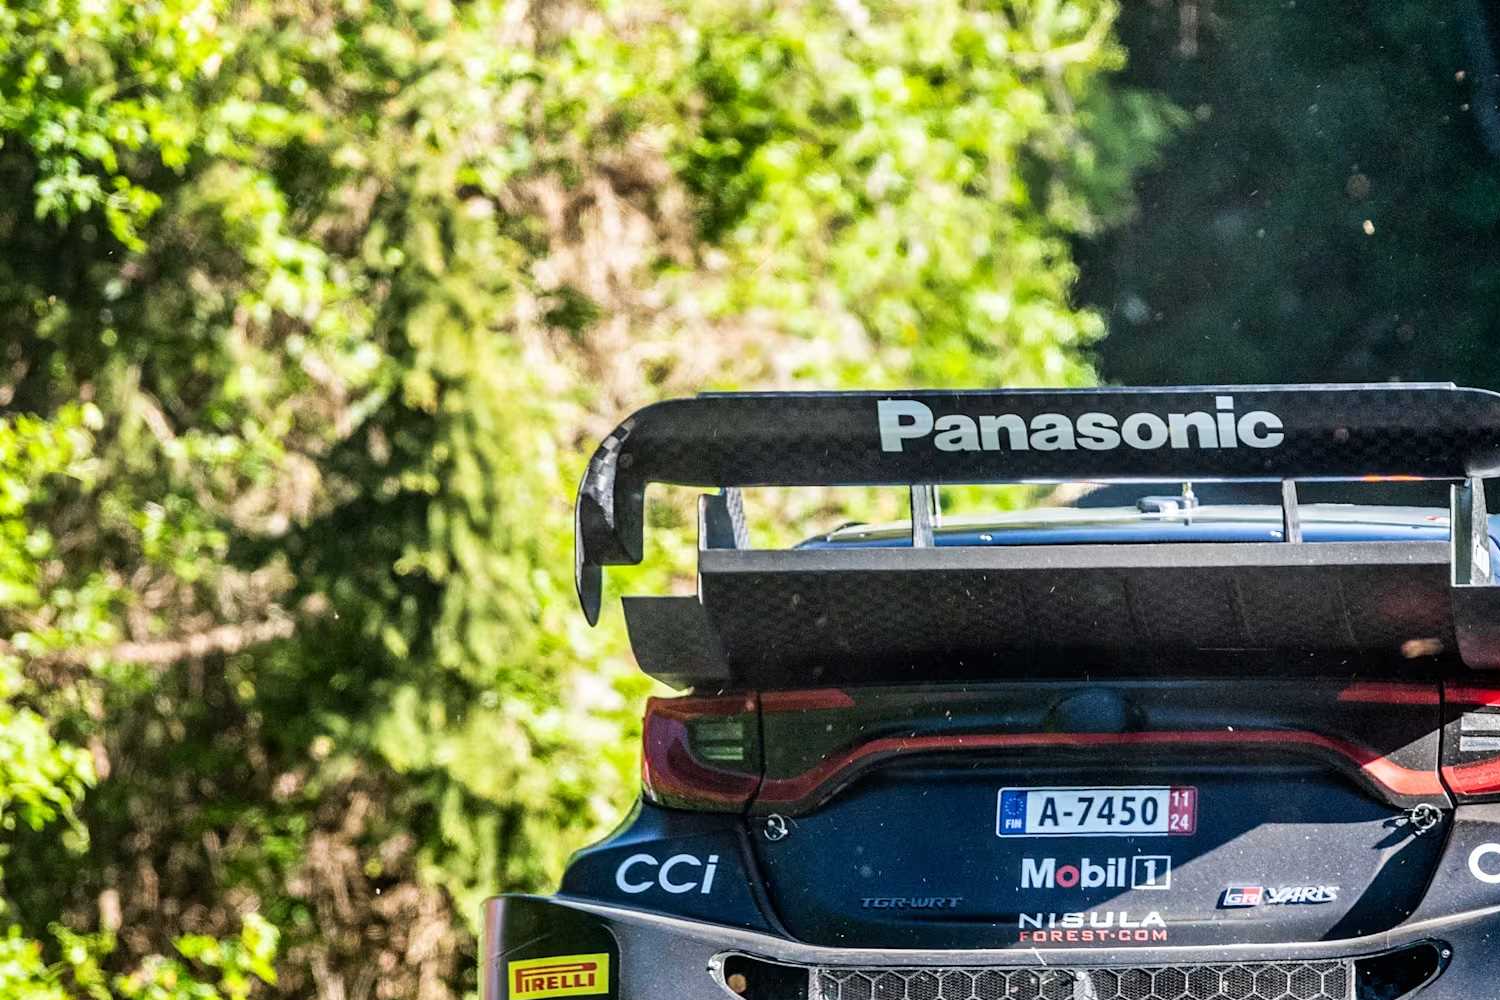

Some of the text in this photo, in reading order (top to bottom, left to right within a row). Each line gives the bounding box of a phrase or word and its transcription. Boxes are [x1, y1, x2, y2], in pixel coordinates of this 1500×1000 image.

[877, 395, 1285, 452] Panasonic
[1171, 791, 1189, 807] 11
[1038, 796, 1158, 827] A-7450
[1005, 818, 1022, 829] FIN
[1170, 813, 1189, 831] 24
[615, 853, 719, 894] CCi
[1021, 857, 1127, 888] Mobil
[860, 897, 963, 908] TGR-WRT
[1264, 885, 1340, 902] YARIS
[1018, 911, 1167, 929] NISULA
[515, 961, 598, 993] PIRELLI
